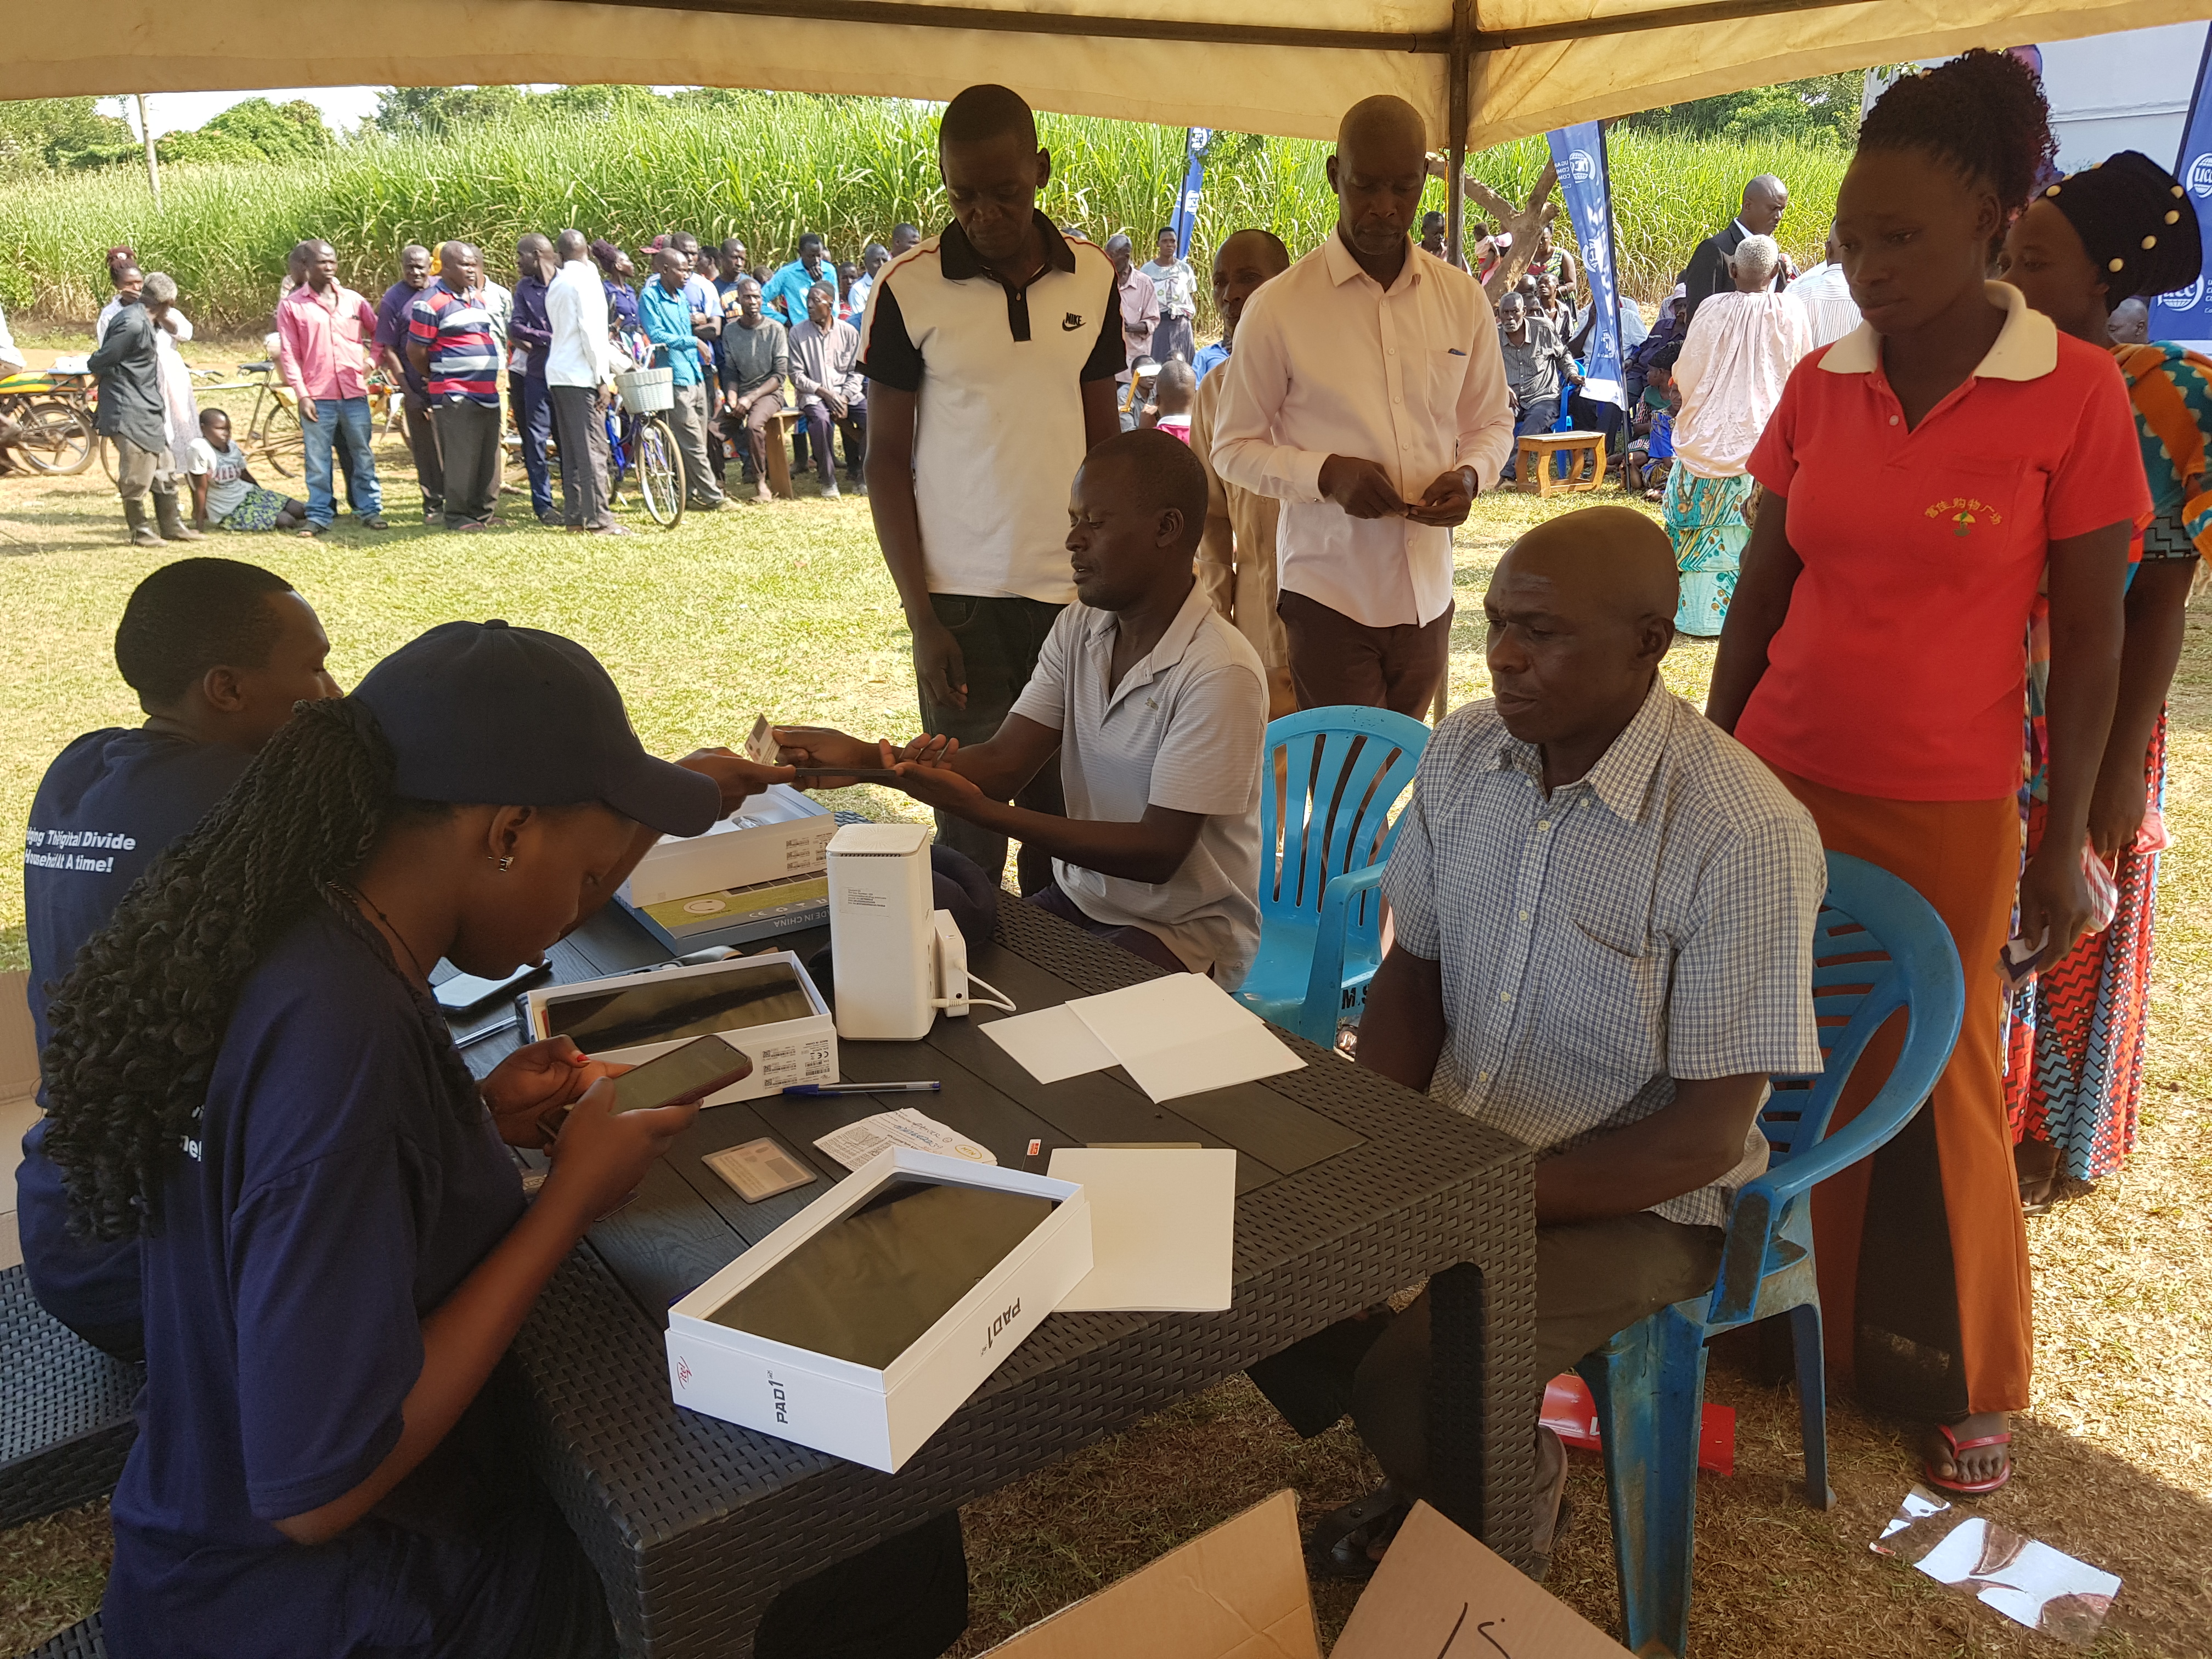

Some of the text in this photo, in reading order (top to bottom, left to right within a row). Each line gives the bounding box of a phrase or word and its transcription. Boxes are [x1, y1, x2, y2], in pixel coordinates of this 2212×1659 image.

[1065, 312, 1082, 325] NIKE
[83, 832, 136, 850] Divide
[65, 854, 73, 869] A
[76, 854, 114, 873] time!
[774, 916, 803, 928] CHINA
[805, 913, 814, 922] IN
[961, 1147, 977, 1156] MTN
[988, 1297, 1021, 1349] PAD1
[768, 1380, 788, 1424] PAD1
